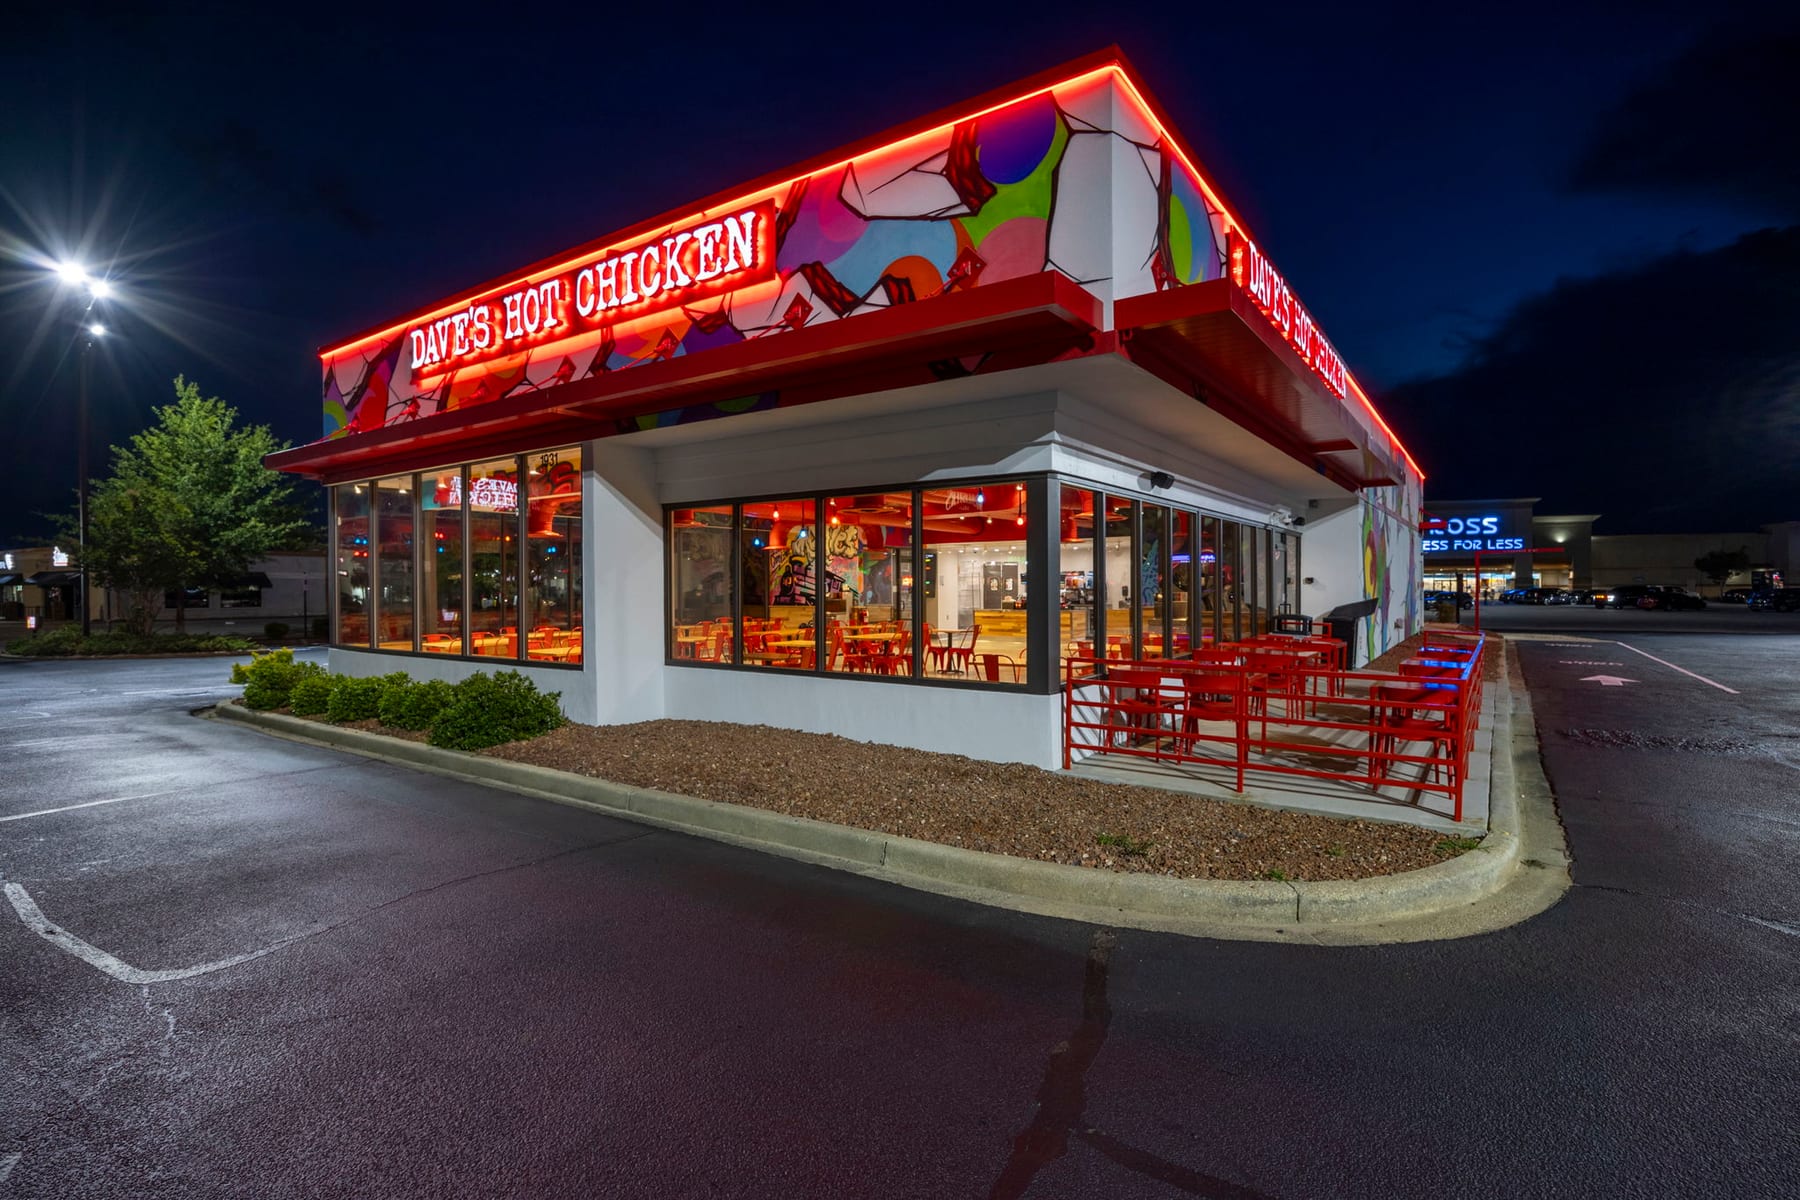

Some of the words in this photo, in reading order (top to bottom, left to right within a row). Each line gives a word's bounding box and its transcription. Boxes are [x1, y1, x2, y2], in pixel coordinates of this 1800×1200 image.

[411, 305, 490, 368] DAVE'S
[504, 281, 560, 339] HOT
[577, 212, 755, 317] CHICKEN
[1249, 240, 1291, 332] DAVE'S
[1294, 302, 1312, 357] HOT
[540, 453, 559, 466] 1931
[1454, 540, 1482, 550] FOR
[1487, 538, 1524, 550] LESS
